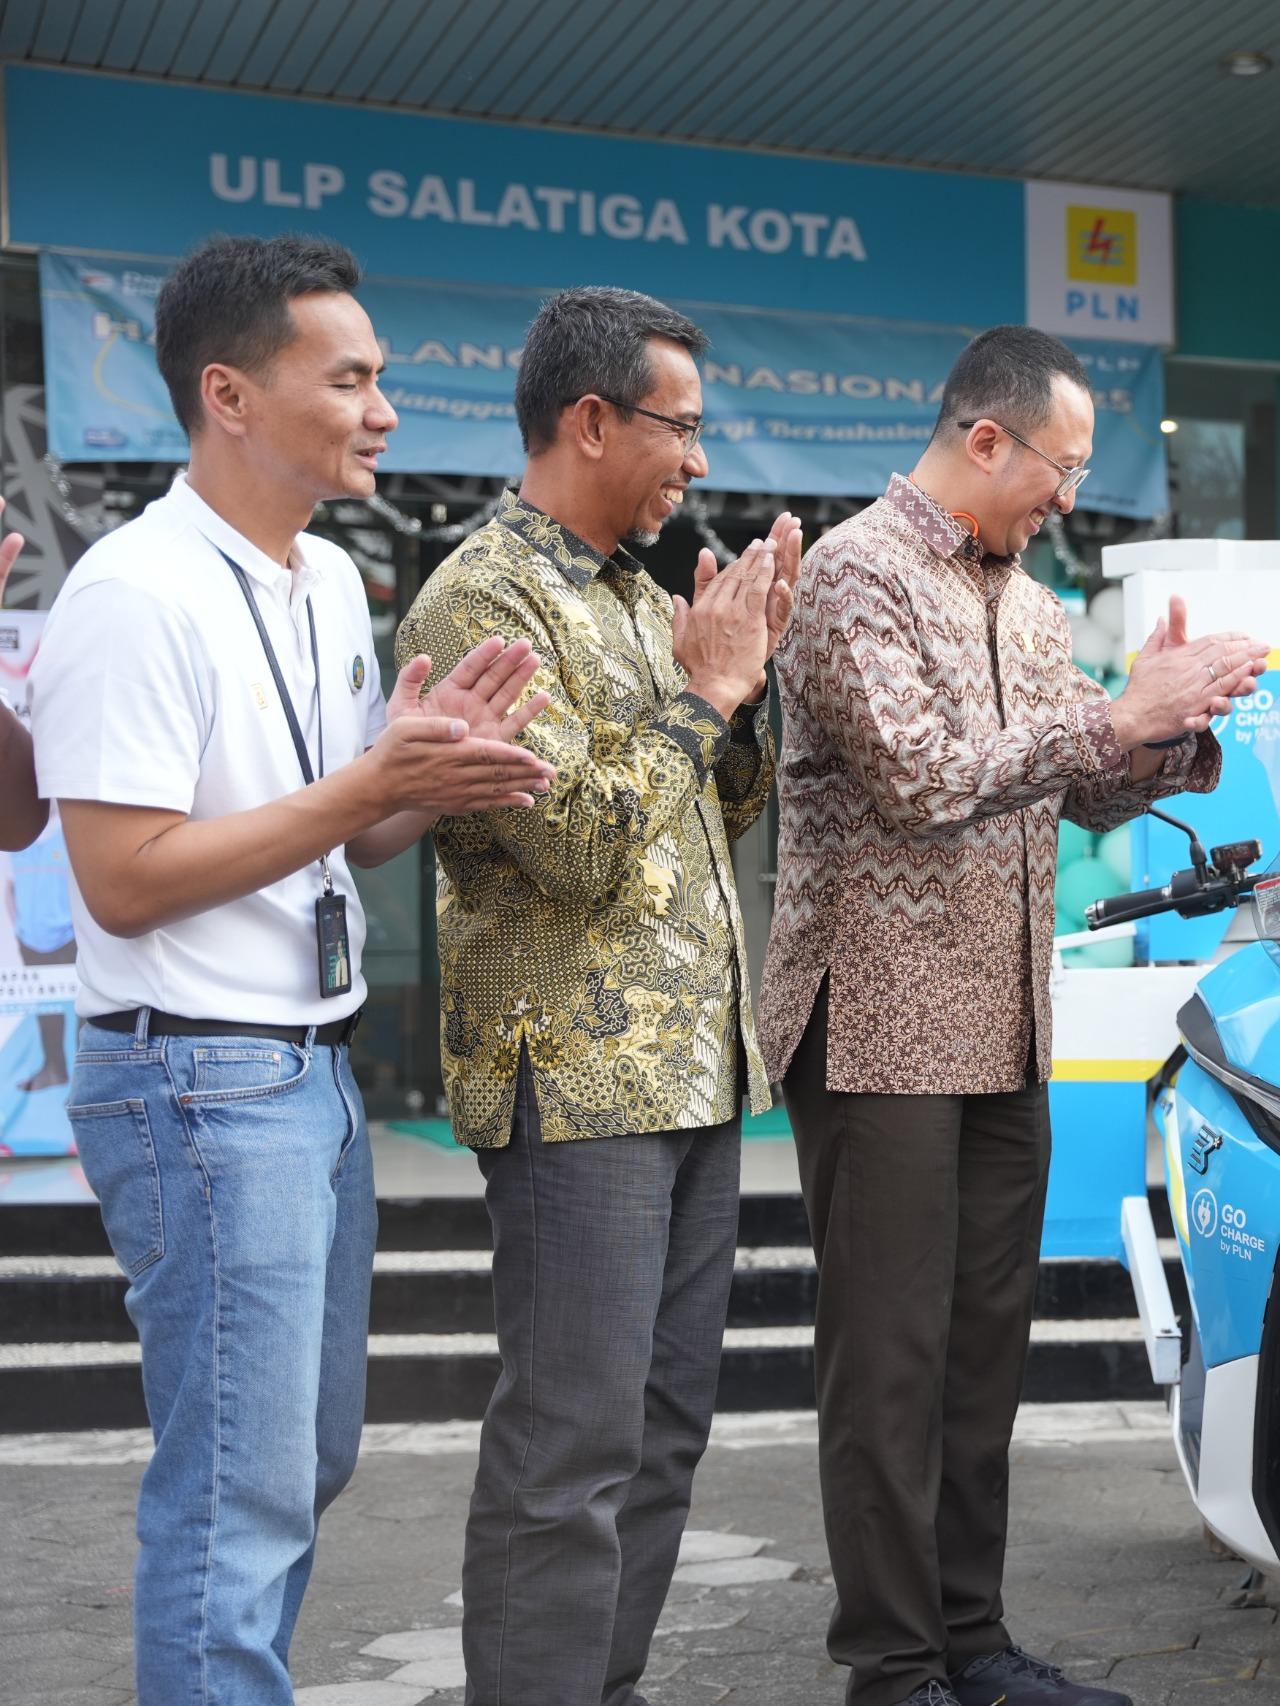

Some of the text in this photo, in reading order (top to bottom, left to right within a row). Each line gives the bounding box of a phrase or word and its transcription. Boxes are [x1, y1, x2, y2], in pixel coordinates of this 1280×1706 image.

[210, 153, 866, 261] ULP SALATIGA KOTA
[1066, 290, 1138, 322] PLN
[703, 361, 944, 404] NASION
[1235, 689, 1274, 711] GO
[1235, 728, 1252, 744] by
[1221, 1204, 1246, 1229] GO
[1220, 1225, 1265, 1252] CHARGE
[1220, 1240, 1252, 1261] by PLN
